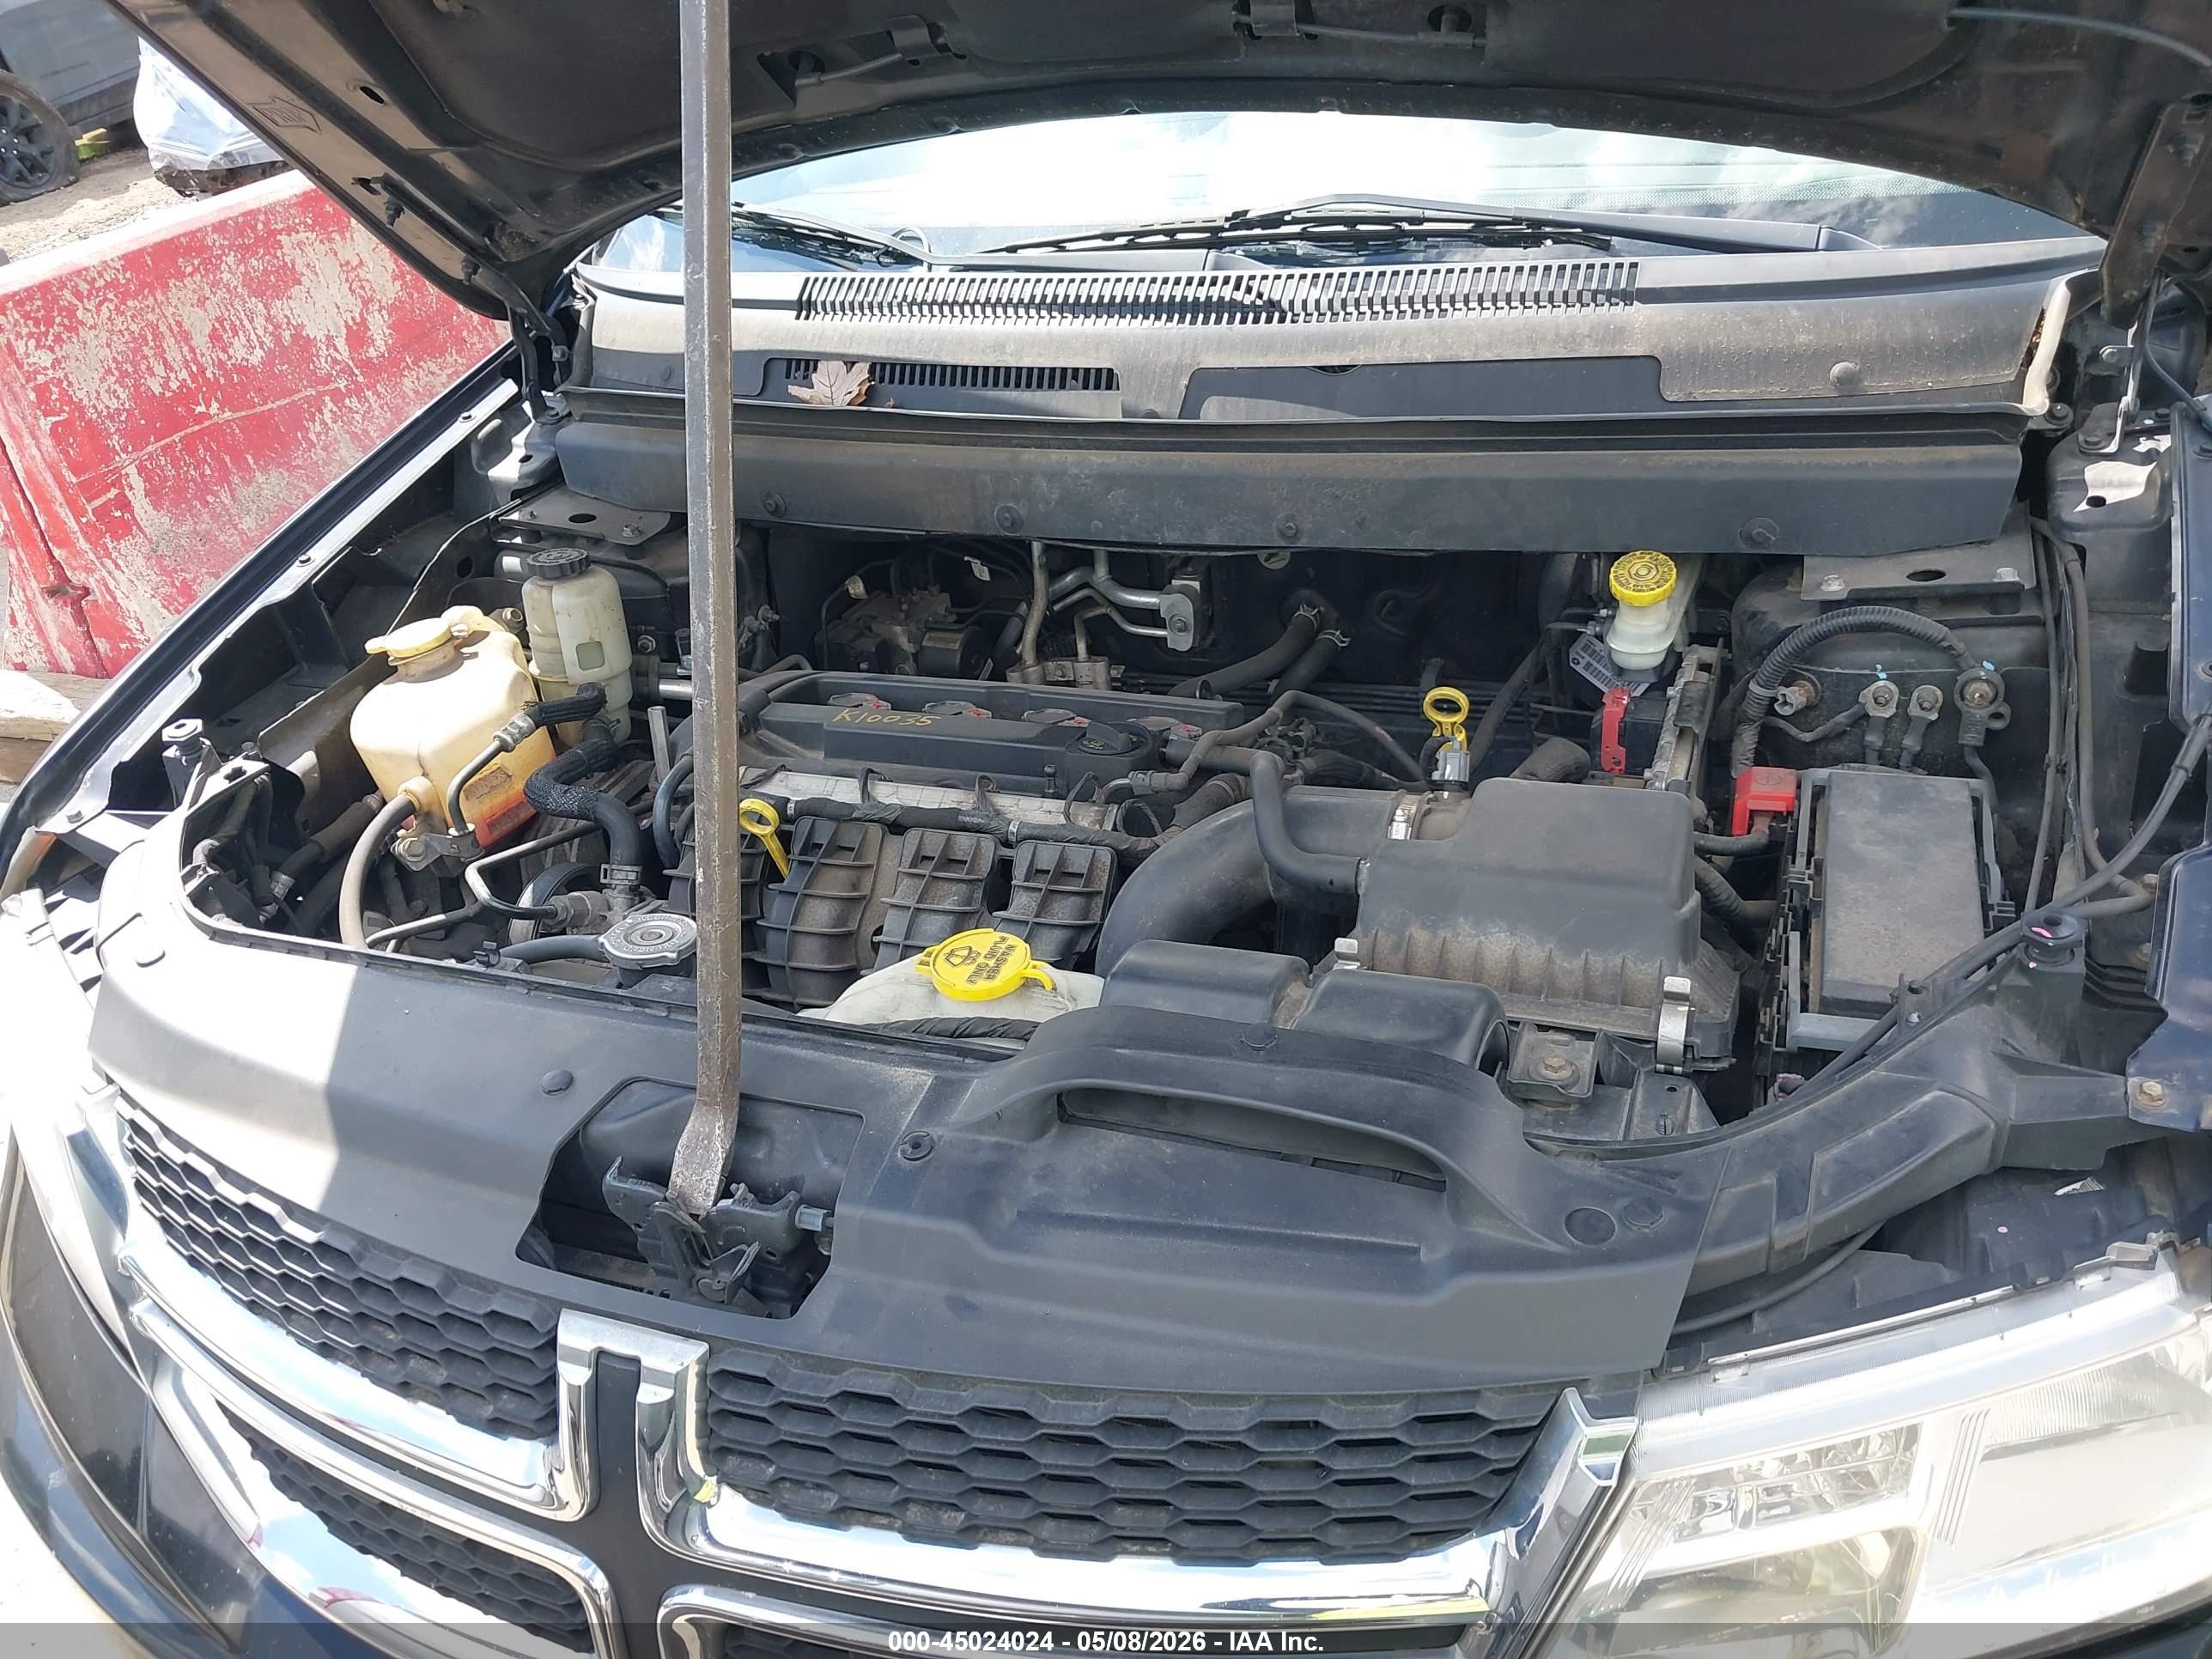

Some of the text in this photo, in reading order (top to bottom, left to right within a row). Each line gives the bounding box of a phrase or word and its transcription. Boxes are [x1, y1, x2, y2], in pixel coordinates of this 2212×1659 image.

[832, 708, 942, 726] K10035
[965, 936, 1010, 985] FLUID ONLY
[983, 944, 1018, 982] WASHER
